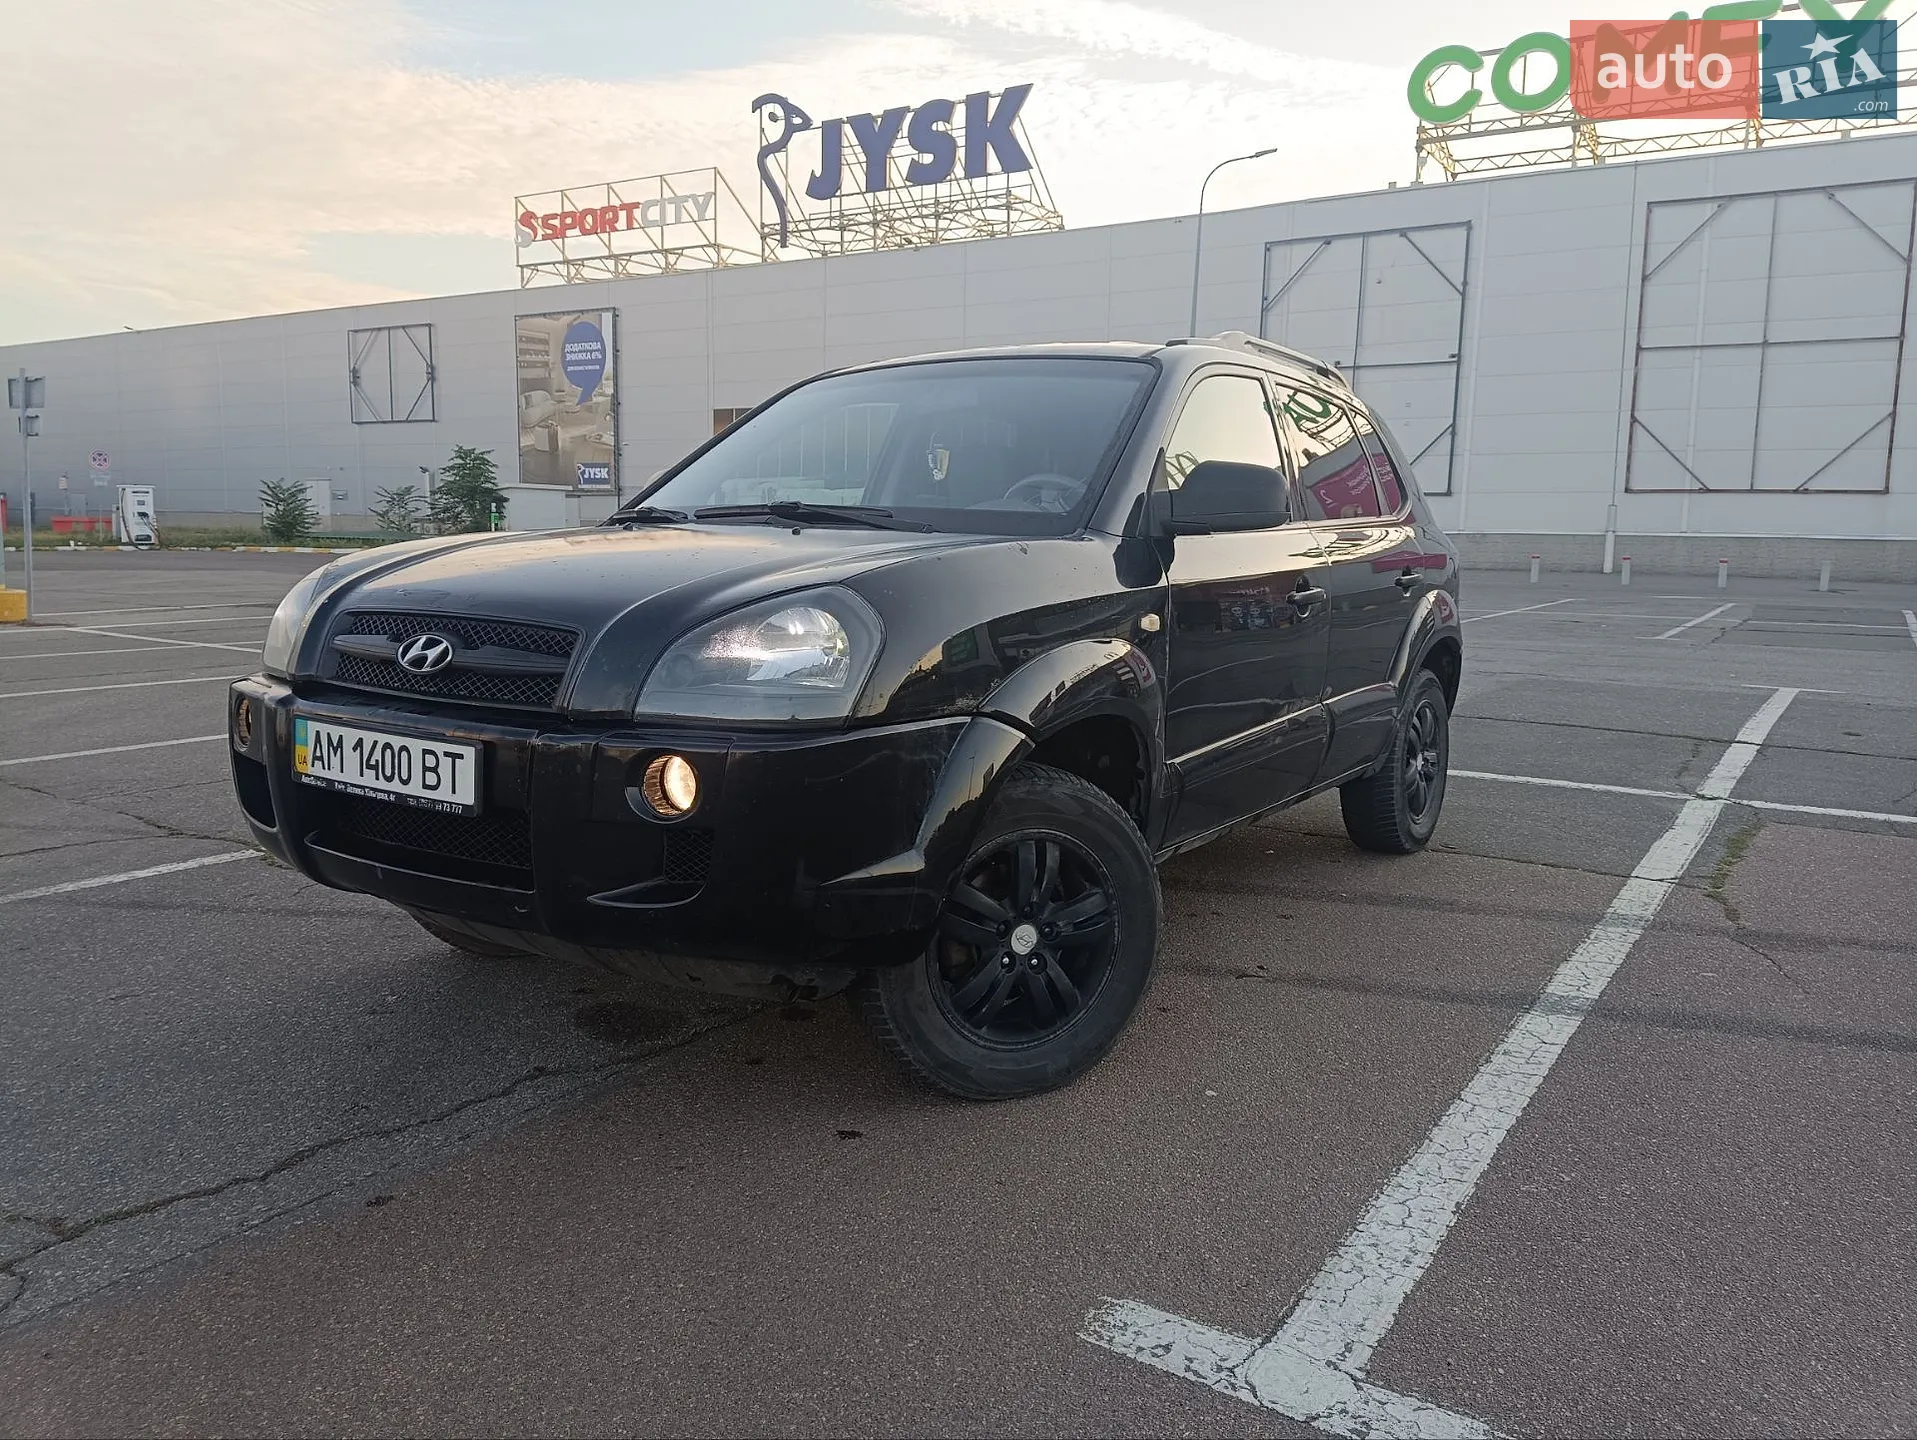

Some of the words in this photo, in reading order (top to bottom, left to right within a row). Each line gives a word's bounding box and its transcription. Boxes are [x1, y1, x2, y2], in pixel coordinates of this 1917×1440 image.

[806, 83, 1034, 200] JYSK
[541, 192, 716, 241] SPORTCITY
[565, 342, 601, 353] ДОДАТКОВА
[583, 467, 609, 479] JYSK
[297, 754, 308, 766] UA
[311, 730, 344, 774] AM
[352, 737, 412, 786] 1400
[421, 748, 465, 795] BT
